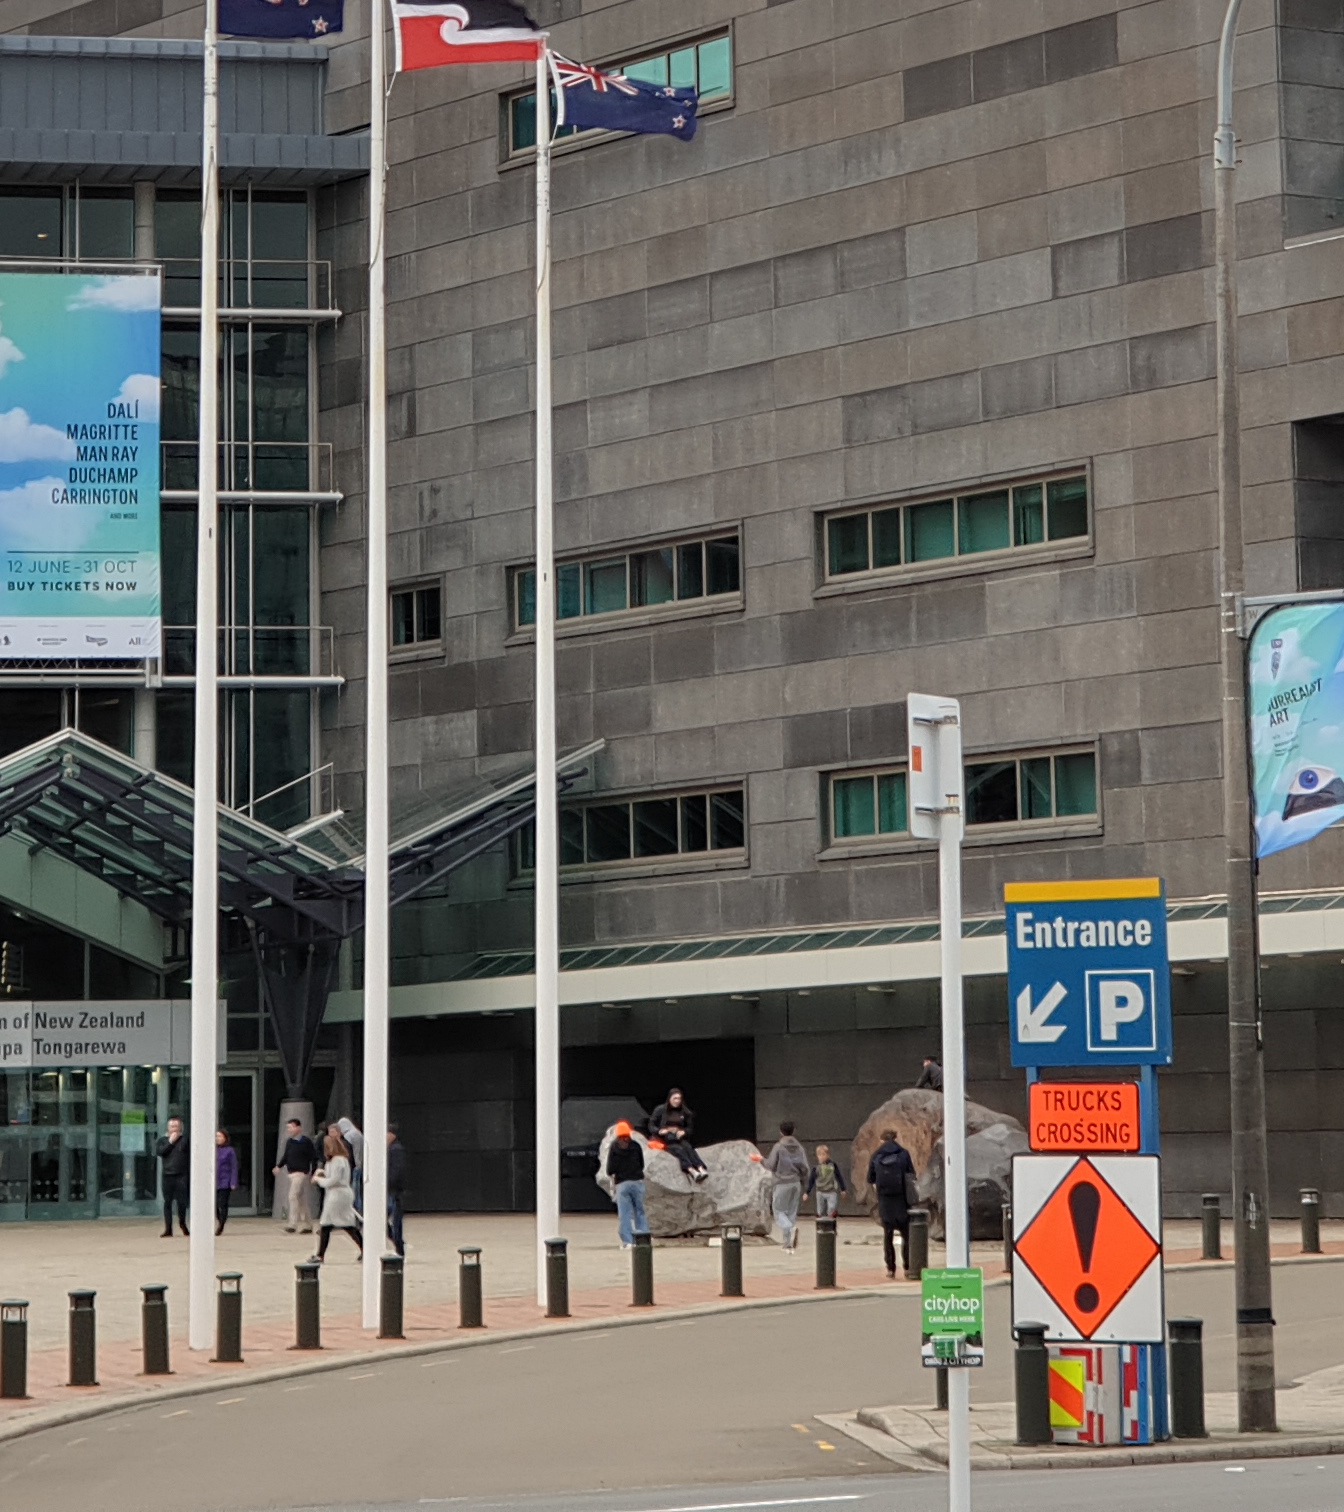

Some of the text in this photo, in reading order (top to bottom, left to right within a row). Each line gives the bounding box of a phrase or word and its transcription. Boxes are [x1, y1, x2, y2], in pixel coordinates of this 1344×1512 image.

[107, 399, 139, 419] DALÍ
[66, 423, 138, 441] MAGRITTE
[76, 445, 138, 462] MAN RAY
[69, 467, 138, 484] DUCHAMP
[51, 487, 138, 505] CARRINGTON
[7, 560, 23, 574] 12
[104, 560, 137, 574] OCT
[7, 581, 138, 592] BUY TICKETS NOW
[1269, 707, 1290, 728] ART
[1016, 912, 1152, 949] Entrance
[12, 1012, 29, 1030] of
[34, 1011, 74, 1029] New
[78, 1011, 145, 1029] Zealand
[1099, 980, 1145, 1041] P
[33, 1038, 126, 1059] Tongarewa
[1042, 1090, 1122, 1111] TRUCKS
[1036, 1122, 1131, 1144] CROSSING
[924, 1293, 980, 1315] cityhop
